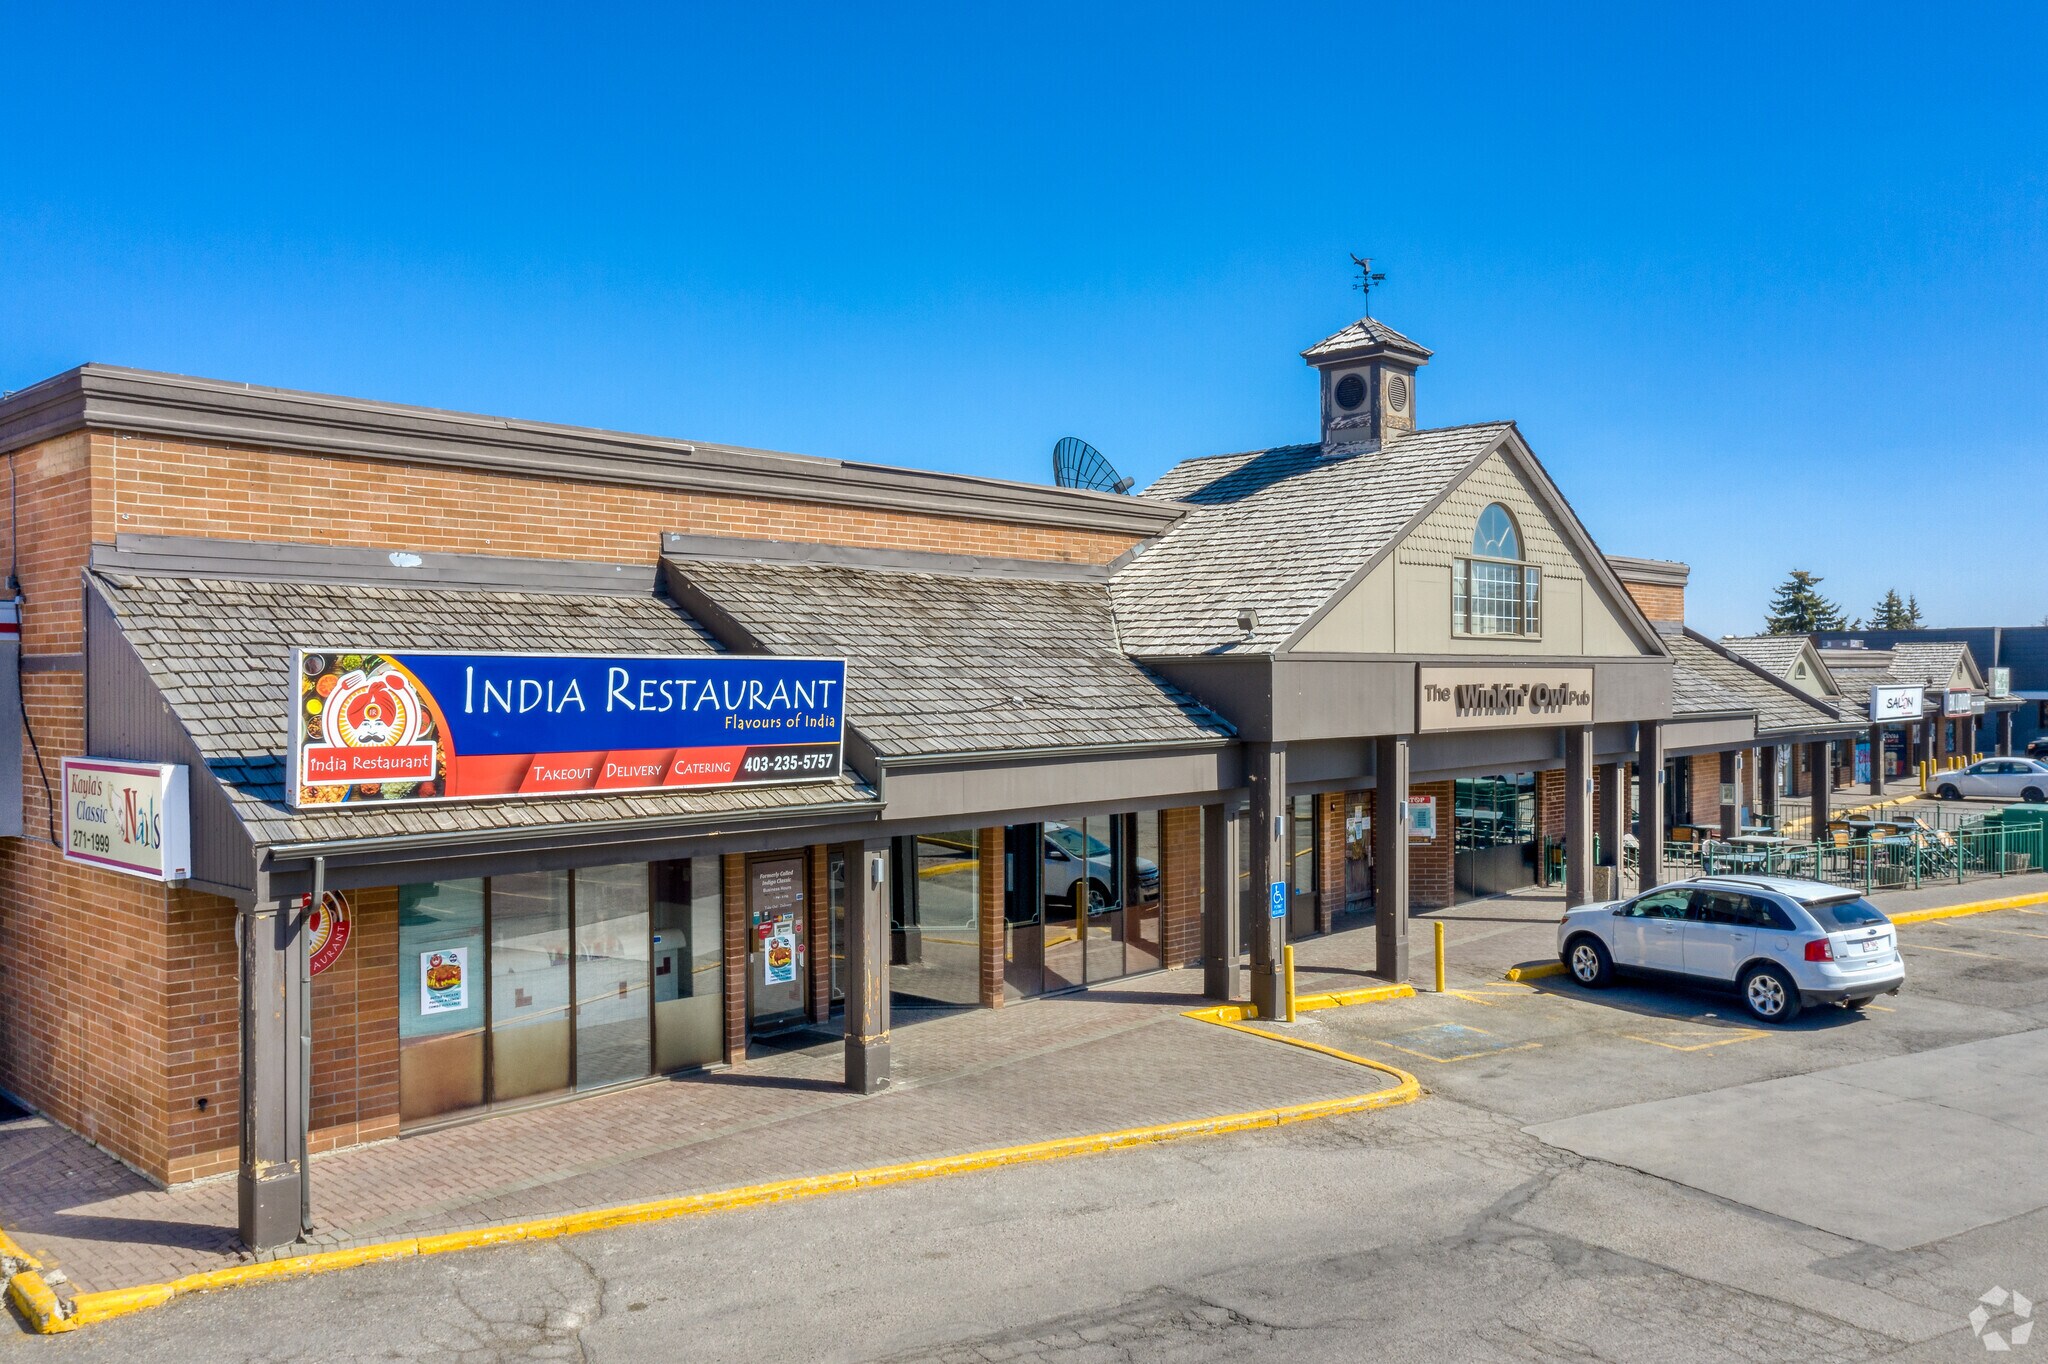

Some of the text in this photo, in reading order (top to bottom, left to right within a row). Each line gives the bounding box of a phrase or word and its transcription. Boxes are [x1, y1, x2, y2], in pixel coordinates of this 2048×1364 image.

[464, 665, 837, 714] INDIA RESTAURANT
[1424, 682, 1591, 713] The Winkin' Owl Pub
[369, 708, 377, 716] IR
[1886, 694, 1914, 710] SALON
[725, 711, 836, 731] Flavours of India
[310, 754, 429, 772] India Restaurant
[606, 763, 662, 778] DELIVERY
[674, 760, 731, 775] CATERING
[744, 753, 833, 772] 403-235-5757
[533, 766, 593, 781] TAKEOUT
[71, 774, 103, 799] Kayla's
[76, 800, 108, 824] Classic
[123, 788, 161, 850] Nails
[73, 830, 110, 853] 271-1999
[313, 925, 346, 971] AURANT
